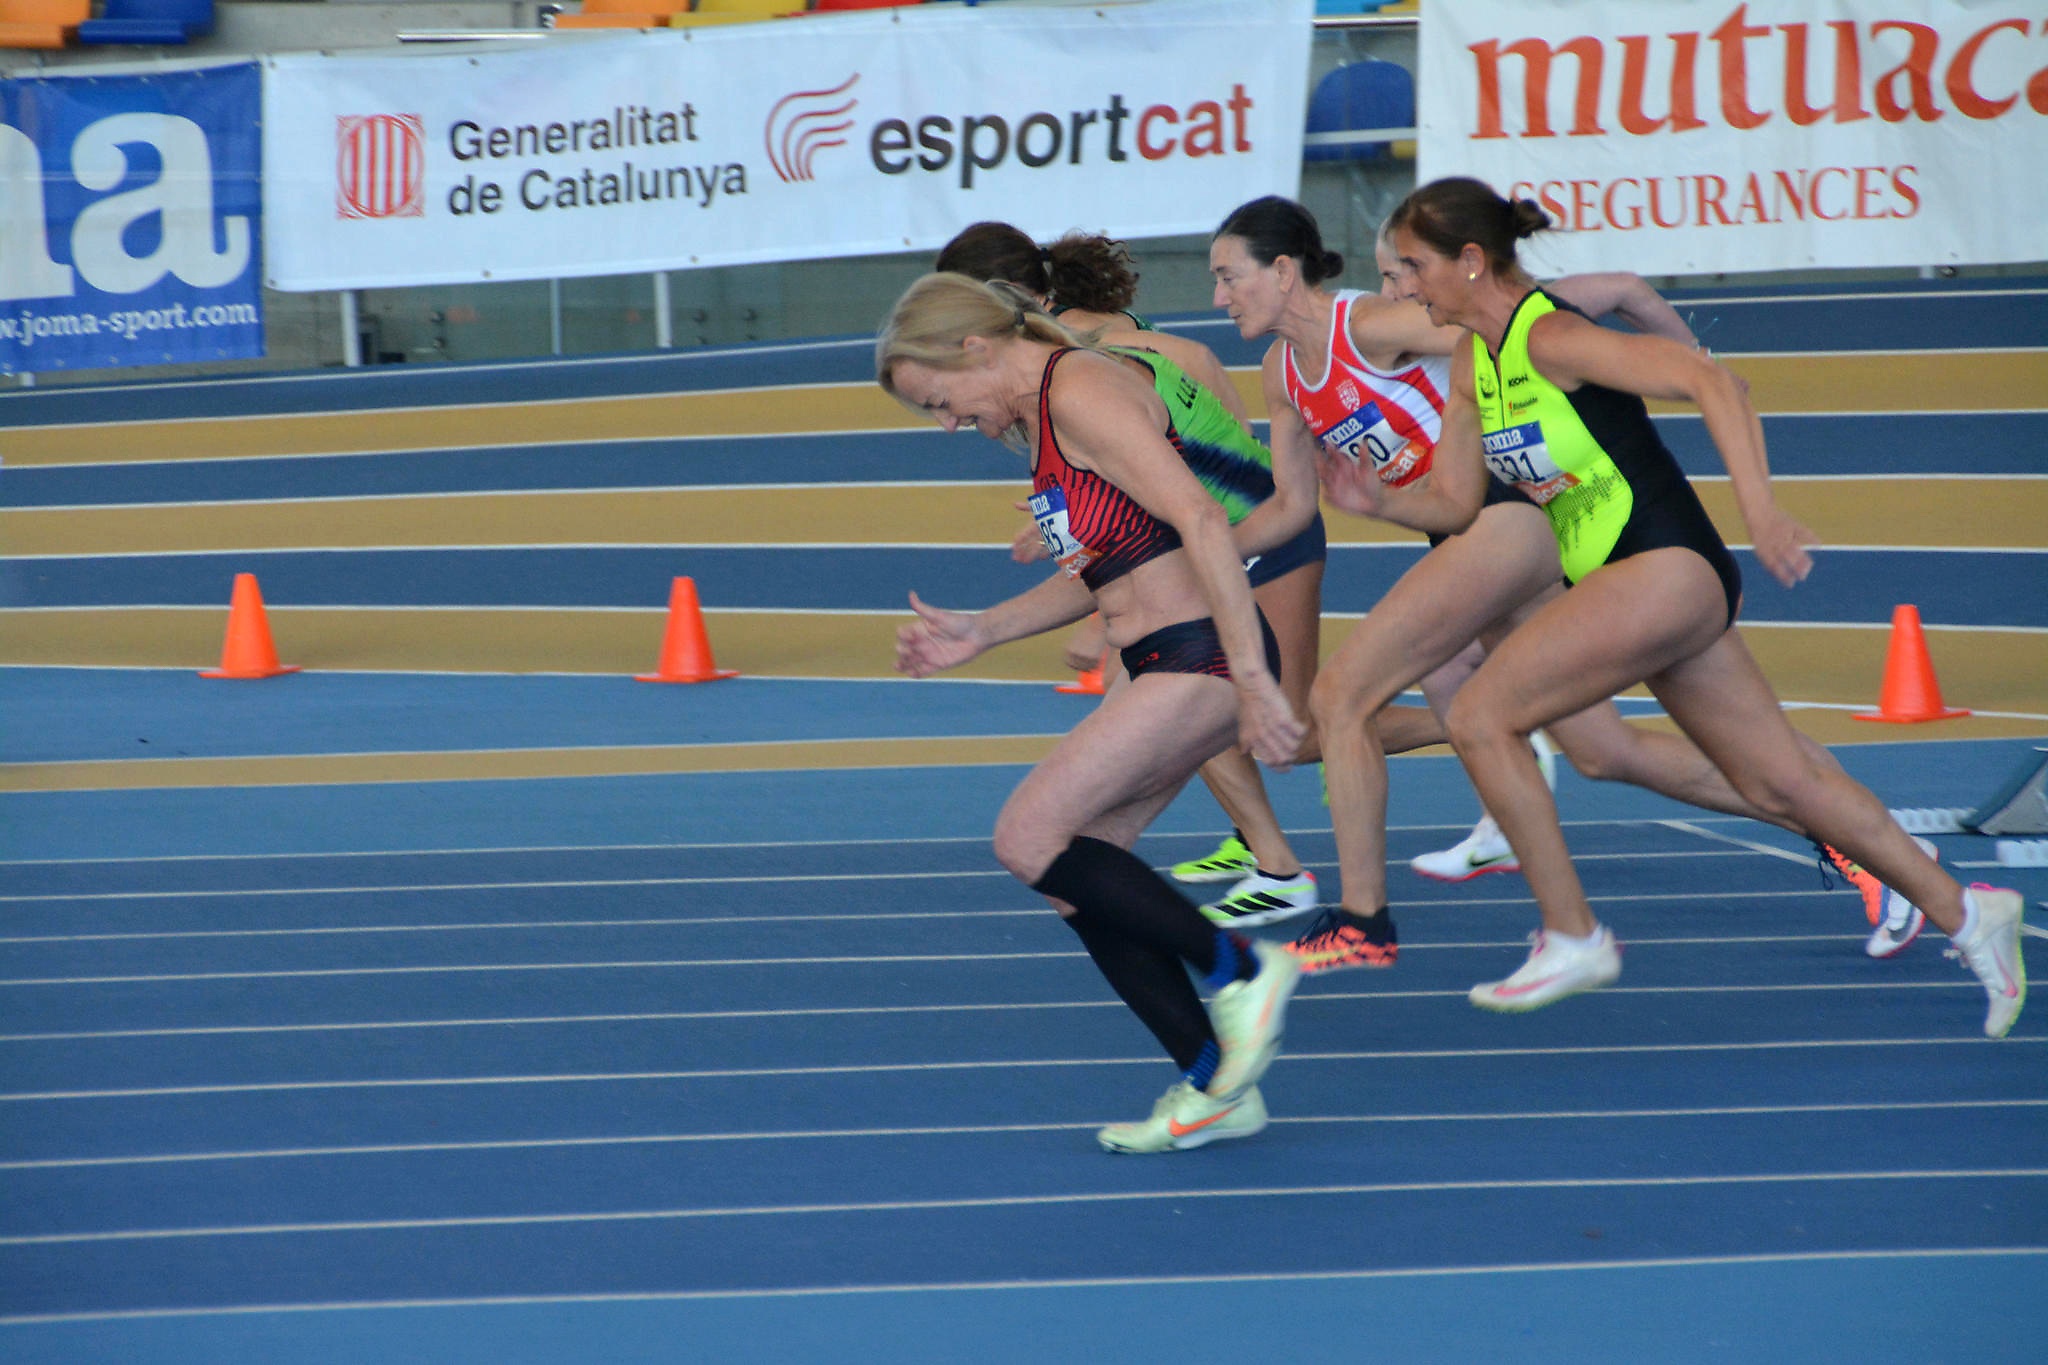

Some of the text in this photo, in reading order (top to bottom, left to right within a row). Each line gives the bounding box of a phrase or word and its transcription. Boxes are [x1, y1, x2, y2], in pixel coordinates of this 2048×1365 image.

[450, 102, 698, 161] Generalitat
[870, 84, 1254, 190] esportcat
[448, 162, 747, 215] de Catalunya
